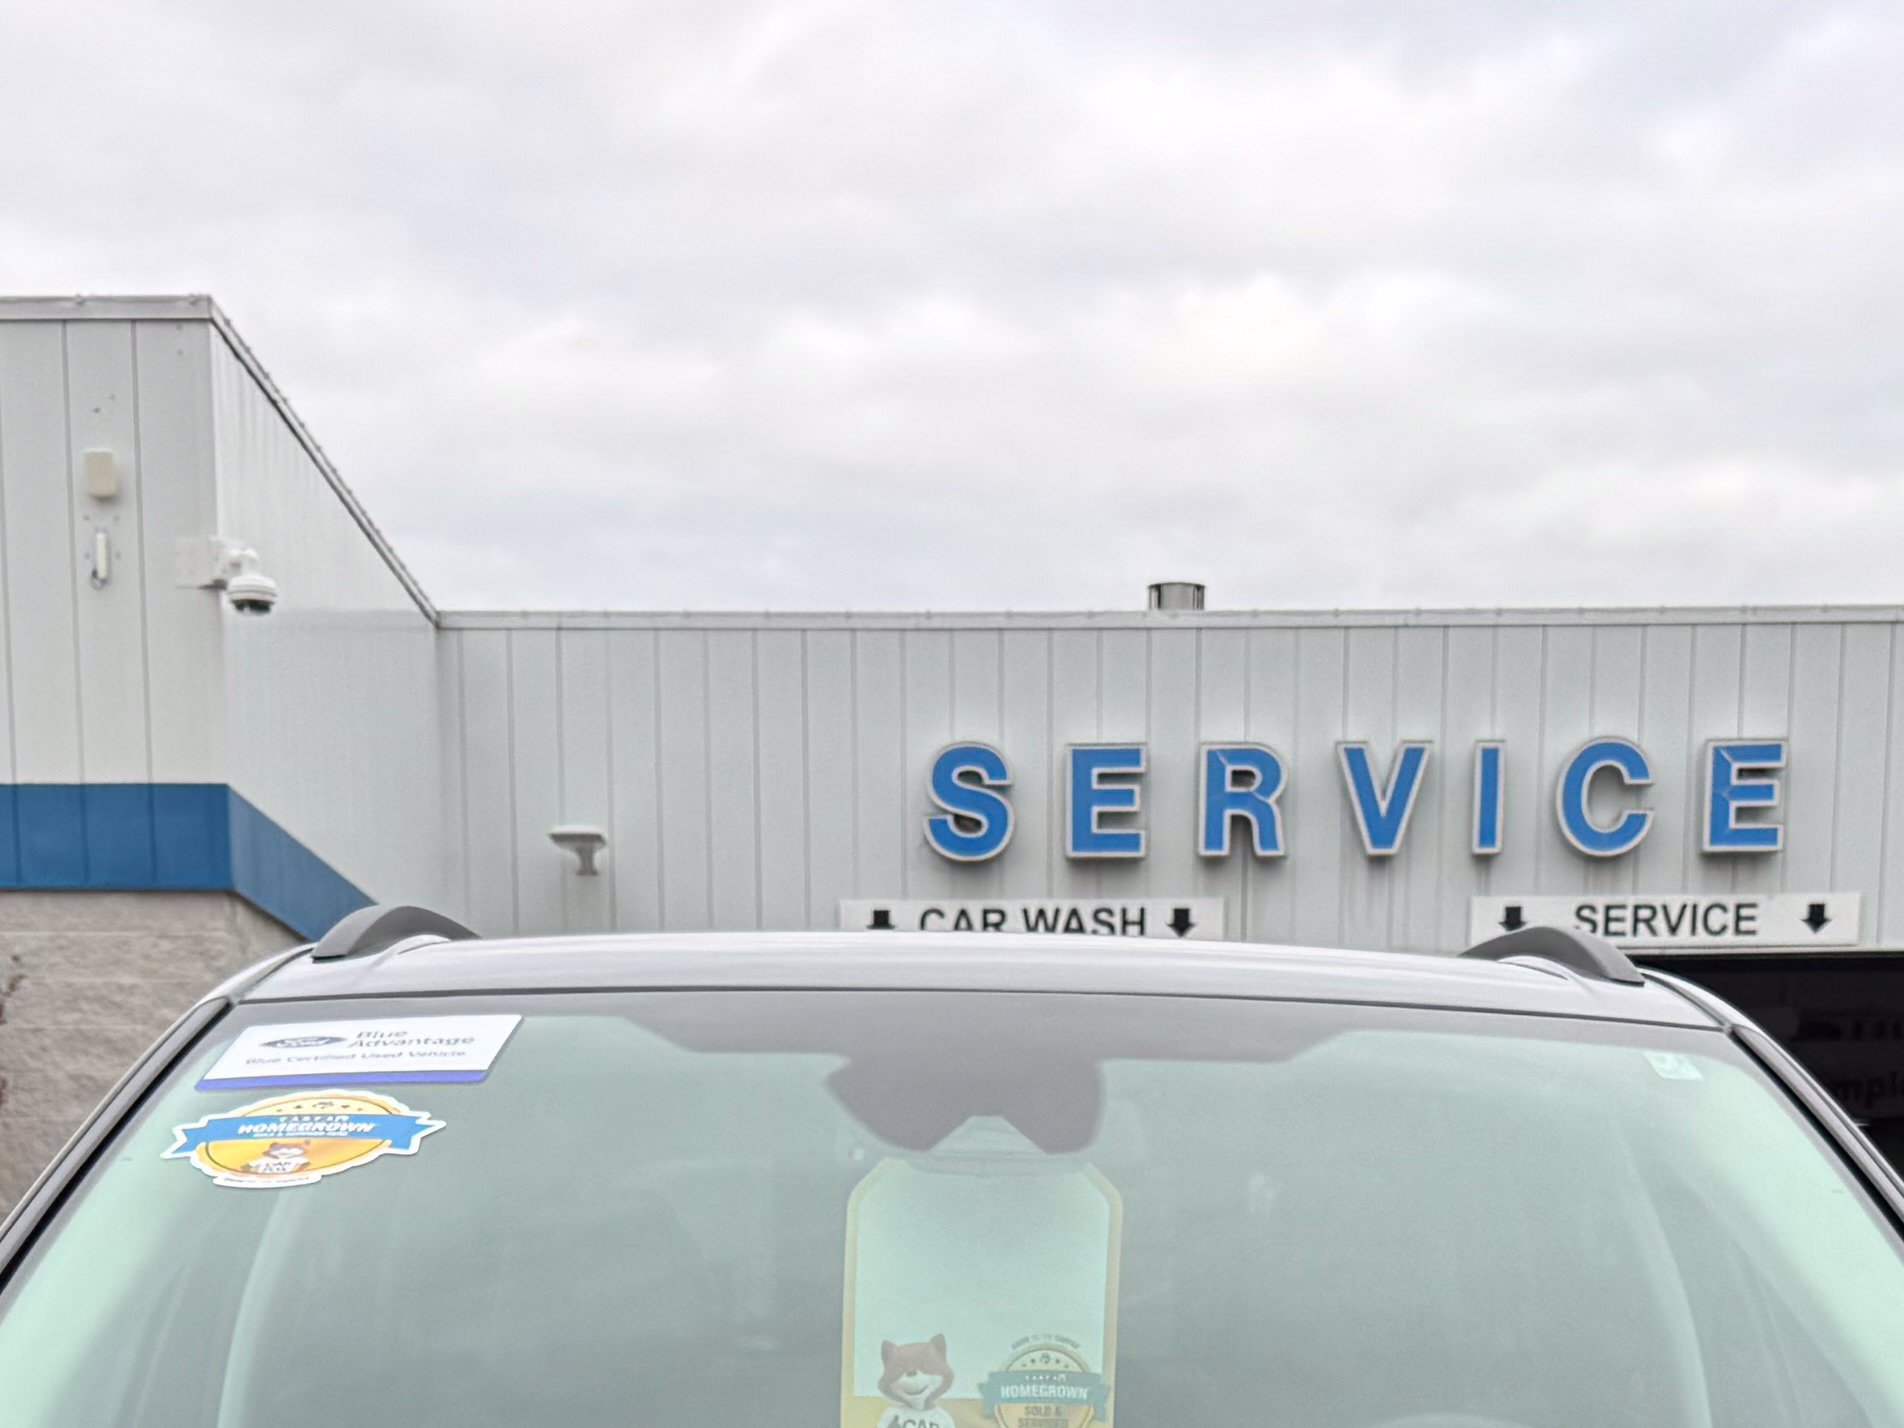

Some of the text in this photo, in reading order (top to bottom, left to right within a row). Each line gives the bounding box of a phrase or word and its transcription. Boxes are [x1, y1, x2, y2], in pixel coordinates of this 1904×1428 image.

[923, 737, 1788, 862] SERVICE
[919, 906, 1146, 936] CAR WASH
[1574, 902, 1758, 938] SERVICE
[347, 1036, 476, 1048] Advantage
[1000, 1384, 1089, 1401] HOMEGROWN
